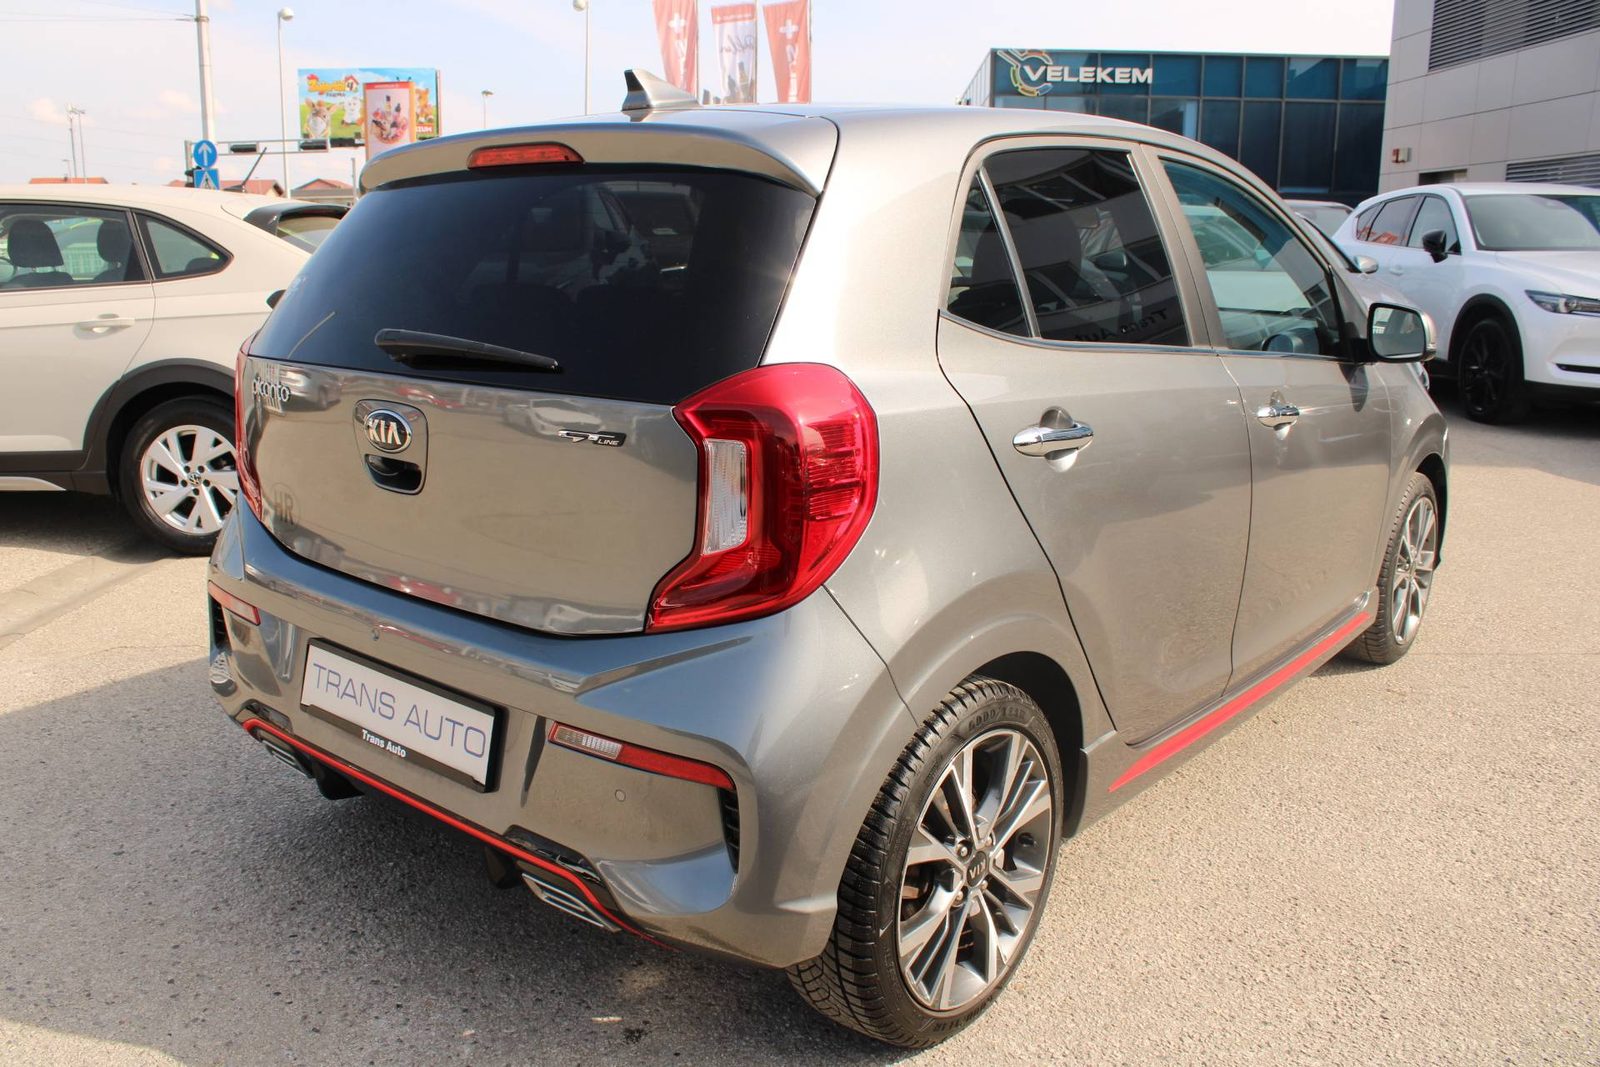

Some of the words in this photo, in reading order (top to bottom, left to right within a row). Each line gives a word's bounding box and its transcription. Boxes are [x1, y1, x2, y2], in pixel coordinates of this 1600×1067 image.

[1023, 65, 1153, 84] VELEKEM
[368, 417, 402, 445] KIA
[313, 662, 397, 721] TRANS
[403, 703, 487, 759] AUTO
[362, 729, 385, 751] Trans
[386, 740, 407, 758] Auto
